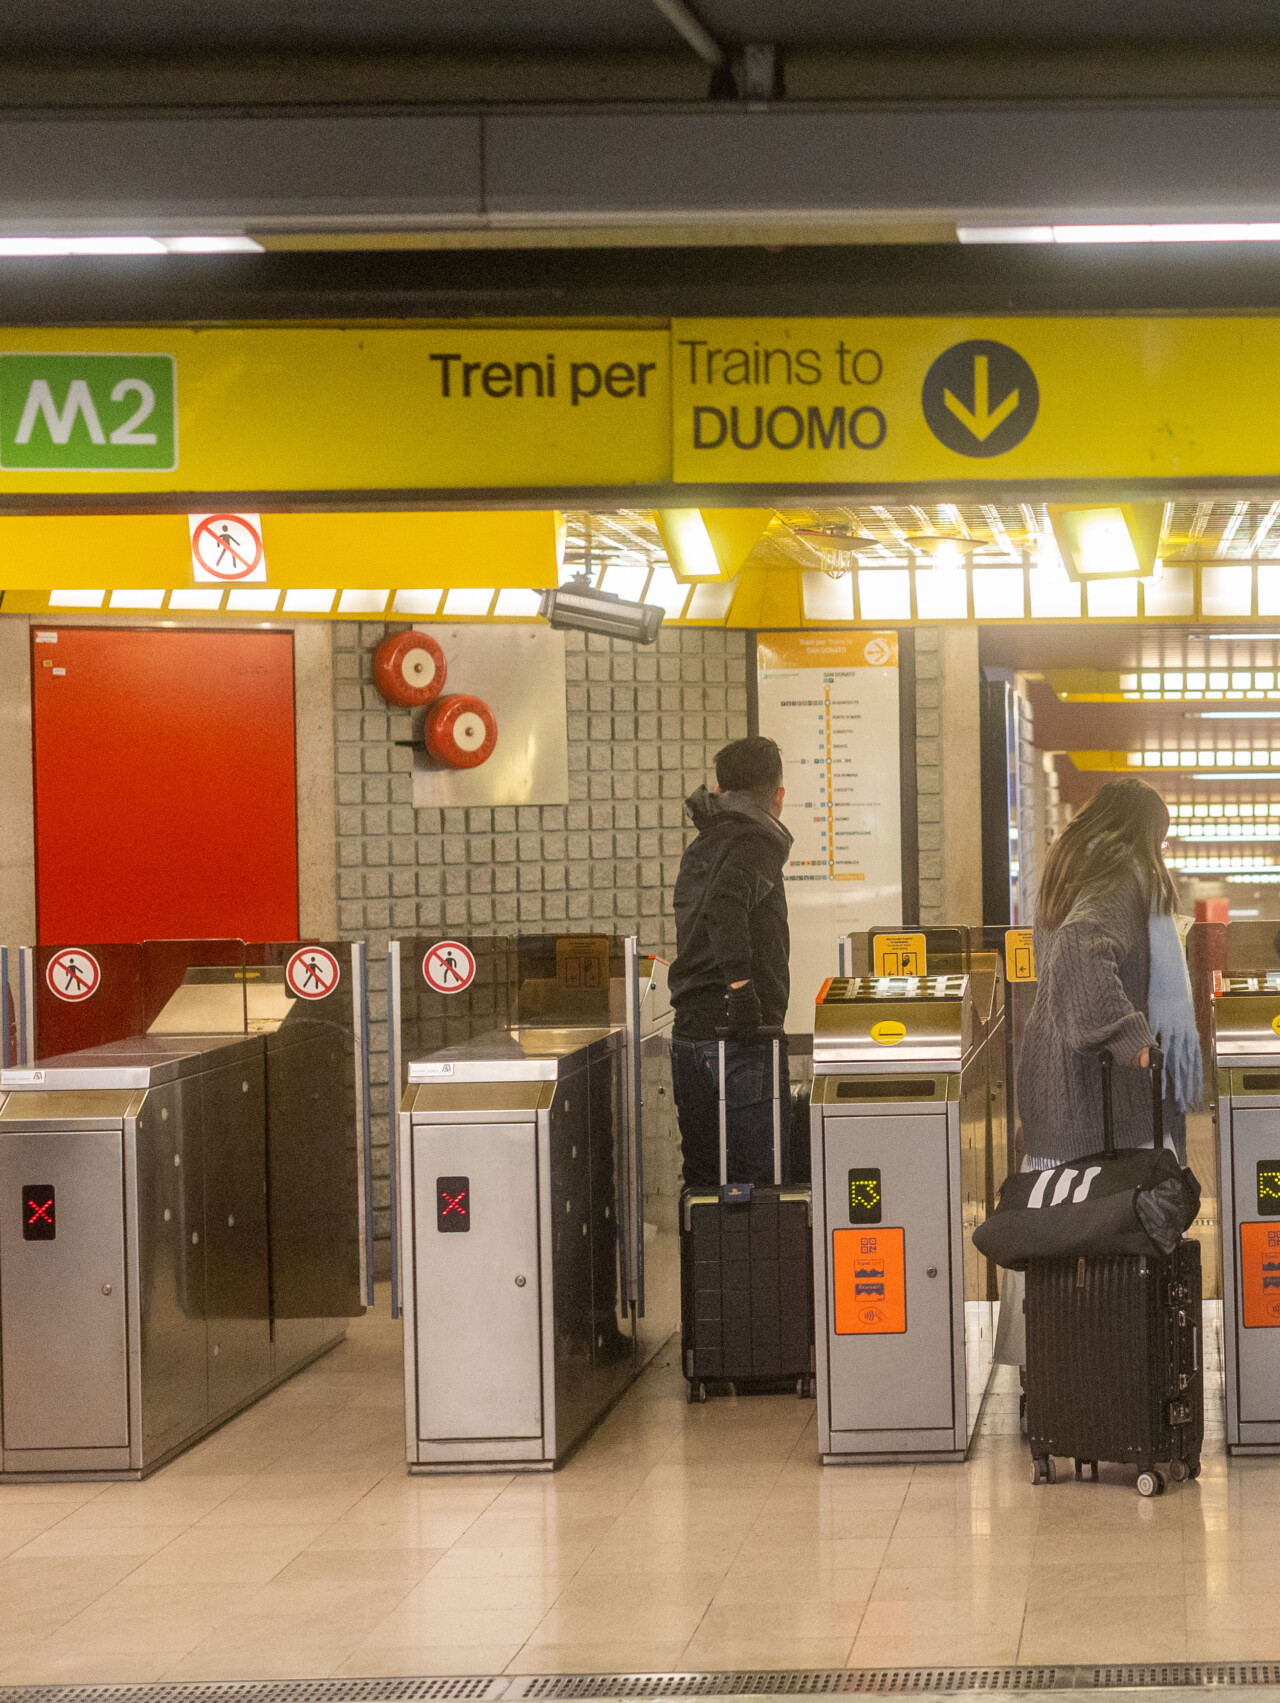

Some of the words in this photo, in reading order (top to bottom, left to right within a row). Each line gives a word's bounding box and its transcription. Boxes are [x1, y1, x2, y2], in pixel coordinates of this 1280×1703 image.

[429, 353, 556, 399] Treni
[570, 360, 658, 407] per
[678, 340, 823, 386] Trains
[835, 340, 884, 386] to
[14, 378, 158, 445] M2
[692, 405, 887, 450] DUOMO
